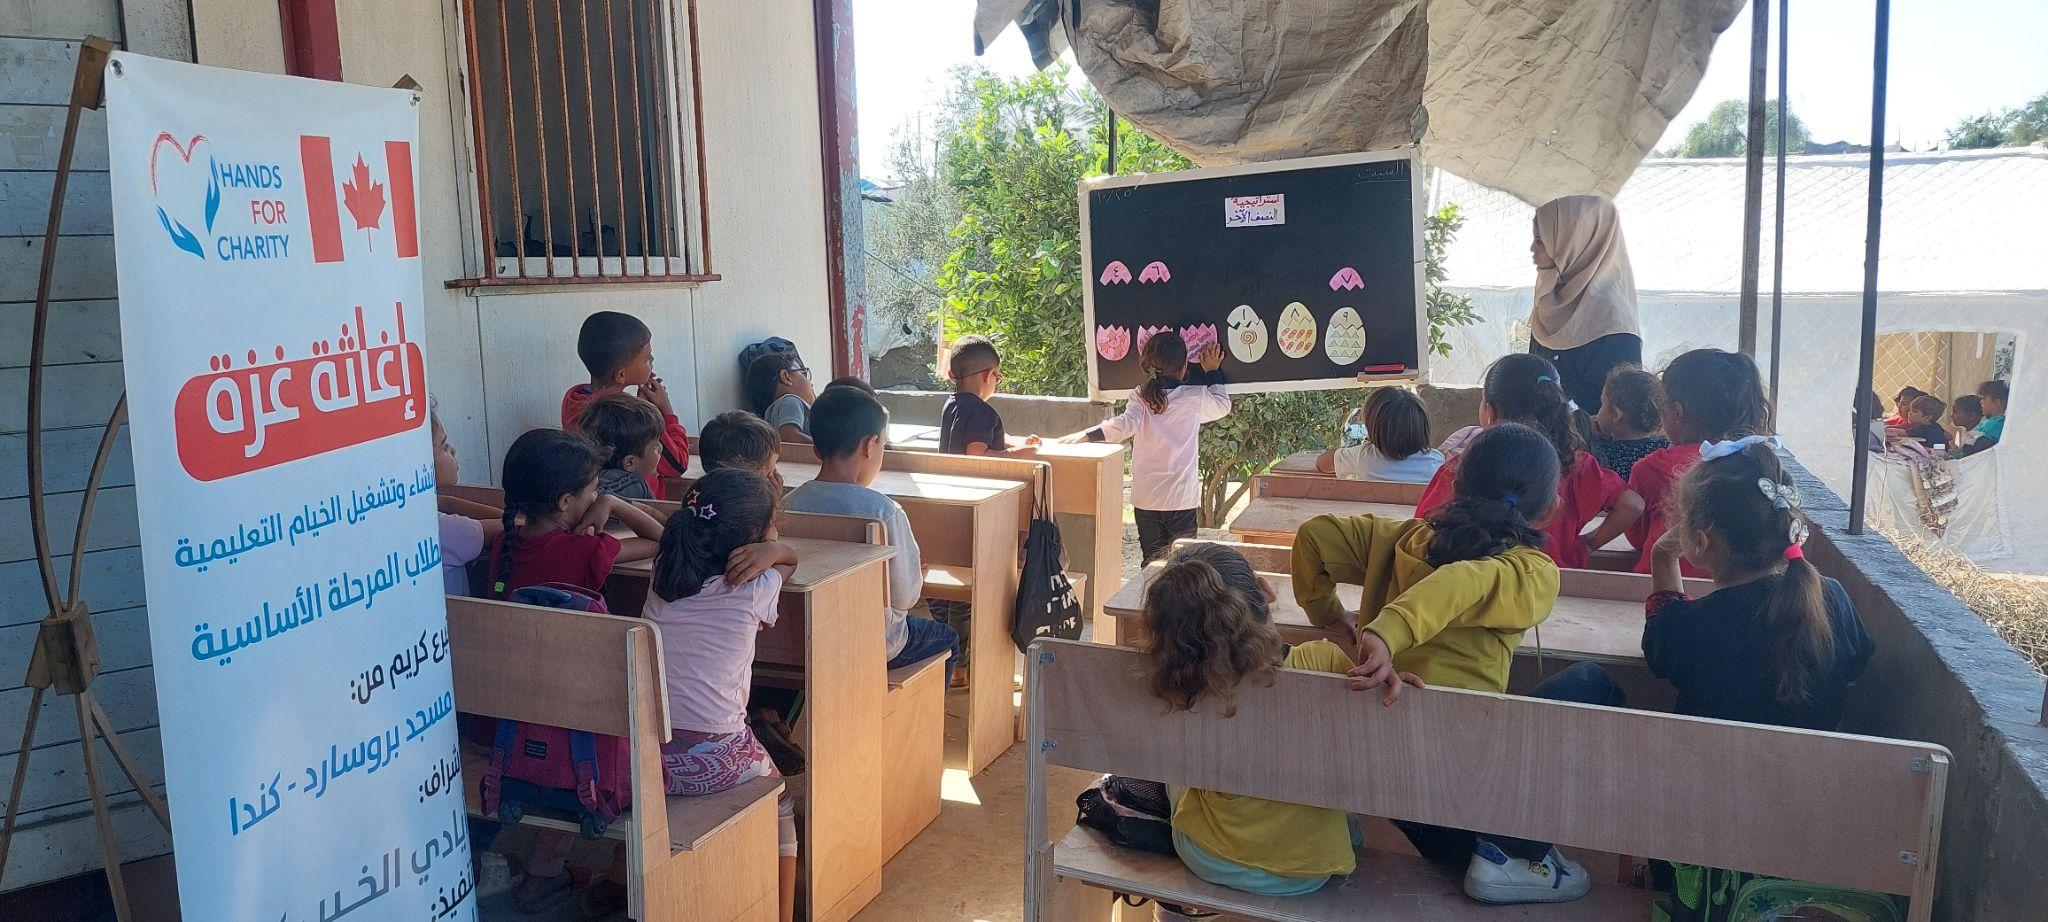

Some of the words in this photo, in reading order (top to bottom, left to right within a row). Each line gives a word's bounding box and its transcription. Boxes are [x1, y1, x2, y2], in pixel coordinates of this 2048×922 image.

[222, 163, 282, 190] HANDS
[251, 199, 288, 225] FOR
[1251, 208, 1278, 221] النصف
[217, 234, 290, 262] CHARITY
[310, 302, 417, 421] إغاثة
[206, 345, 300, 459] غزة
[289, 495, 342, 547] الخيام
[346, 477, 406, 526] وتشغيل
[174, 512, 283, 574] التعليمية
[405, 537, 441, 586] طلاب
[328, 552, 400, 611] المرحلة
[191, 583, 322, 666] الأساسية
[350, 664, 385, 705] من:
[389, 628, 428, 689] كريم
[405, 690, 453, 742] مسجد
[304, 725, 400, 799] بروسارد
[418, 743, 460, 804] شراف:
[229, 771, 281, 836] كندا
